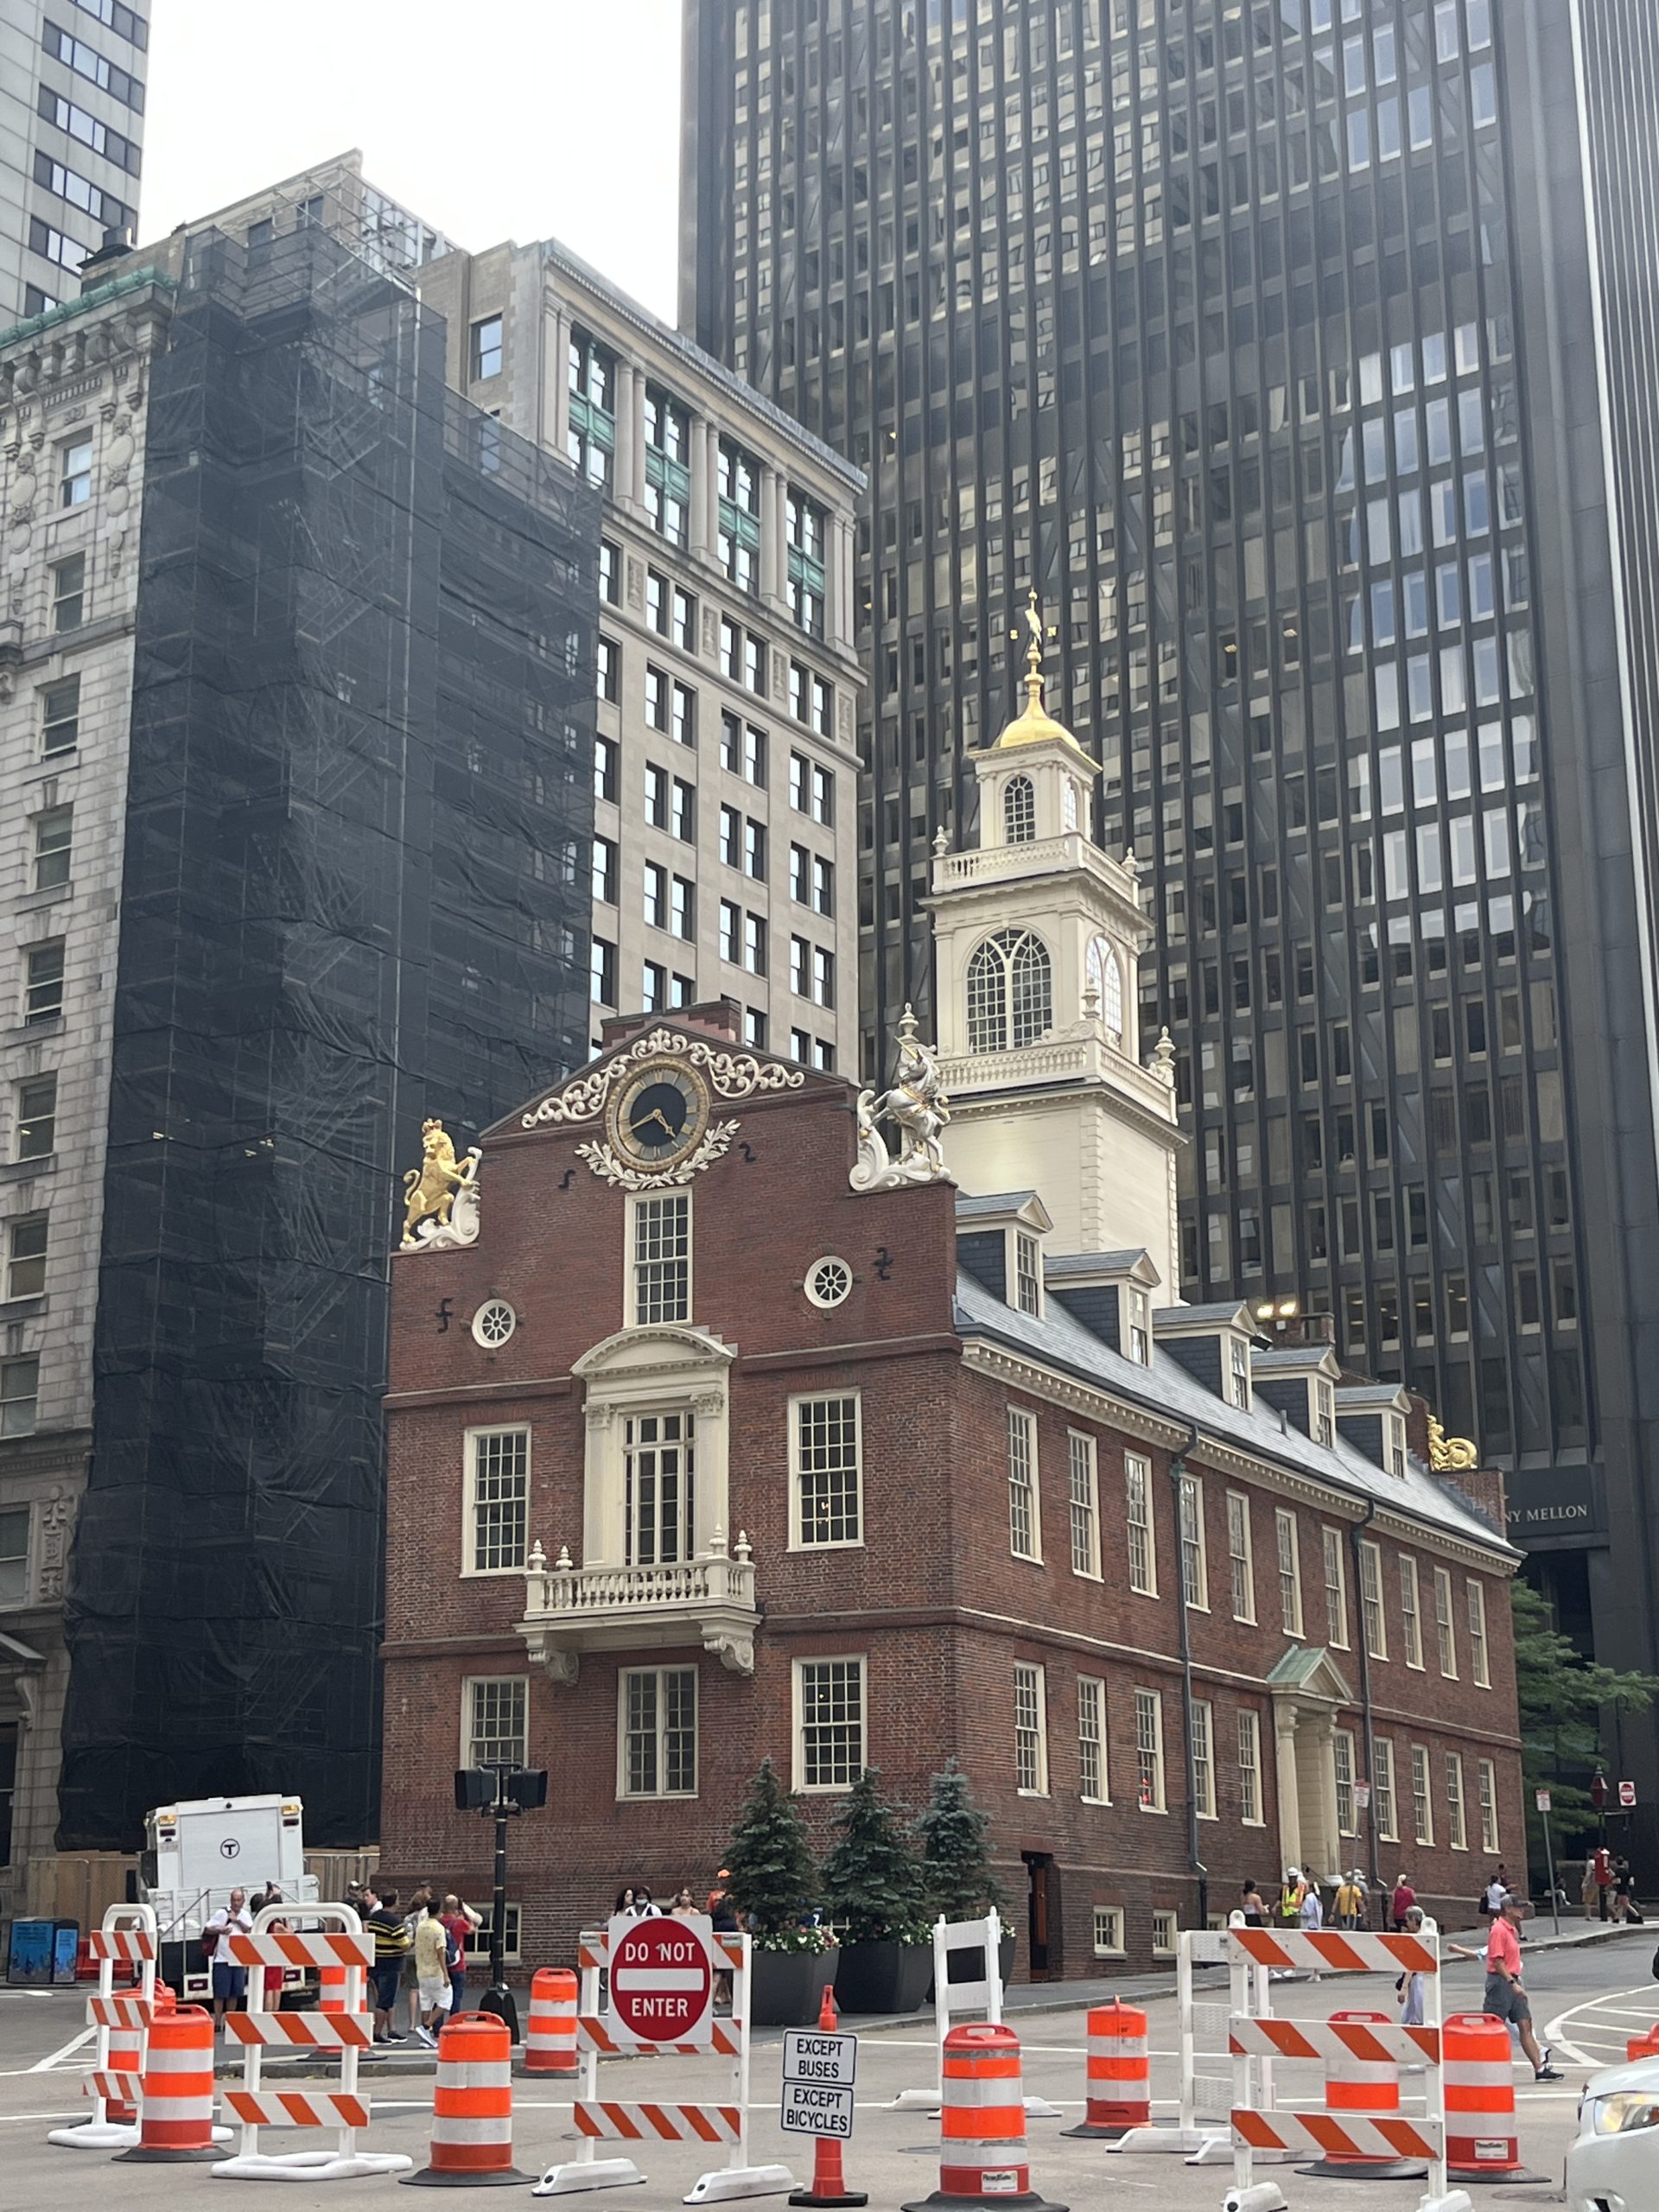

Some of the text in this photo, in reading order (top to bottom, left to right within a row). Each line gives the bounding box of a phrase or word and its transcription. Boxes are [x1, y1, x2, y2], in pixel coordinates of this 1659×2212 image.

[1526, 1504, 1587, 1522] MELLON
[625, 1942, 696, 1962] DO NOT
[631, 1998, 689, 2018] ENTER
[797, 2038, 843, 2056] EXCEPT
[798, 2060, 839, 2078] BUSES
[793, 2088, 842, 2109] EXCEPT
[786, 2109, 848, 2132] BICYCLES
